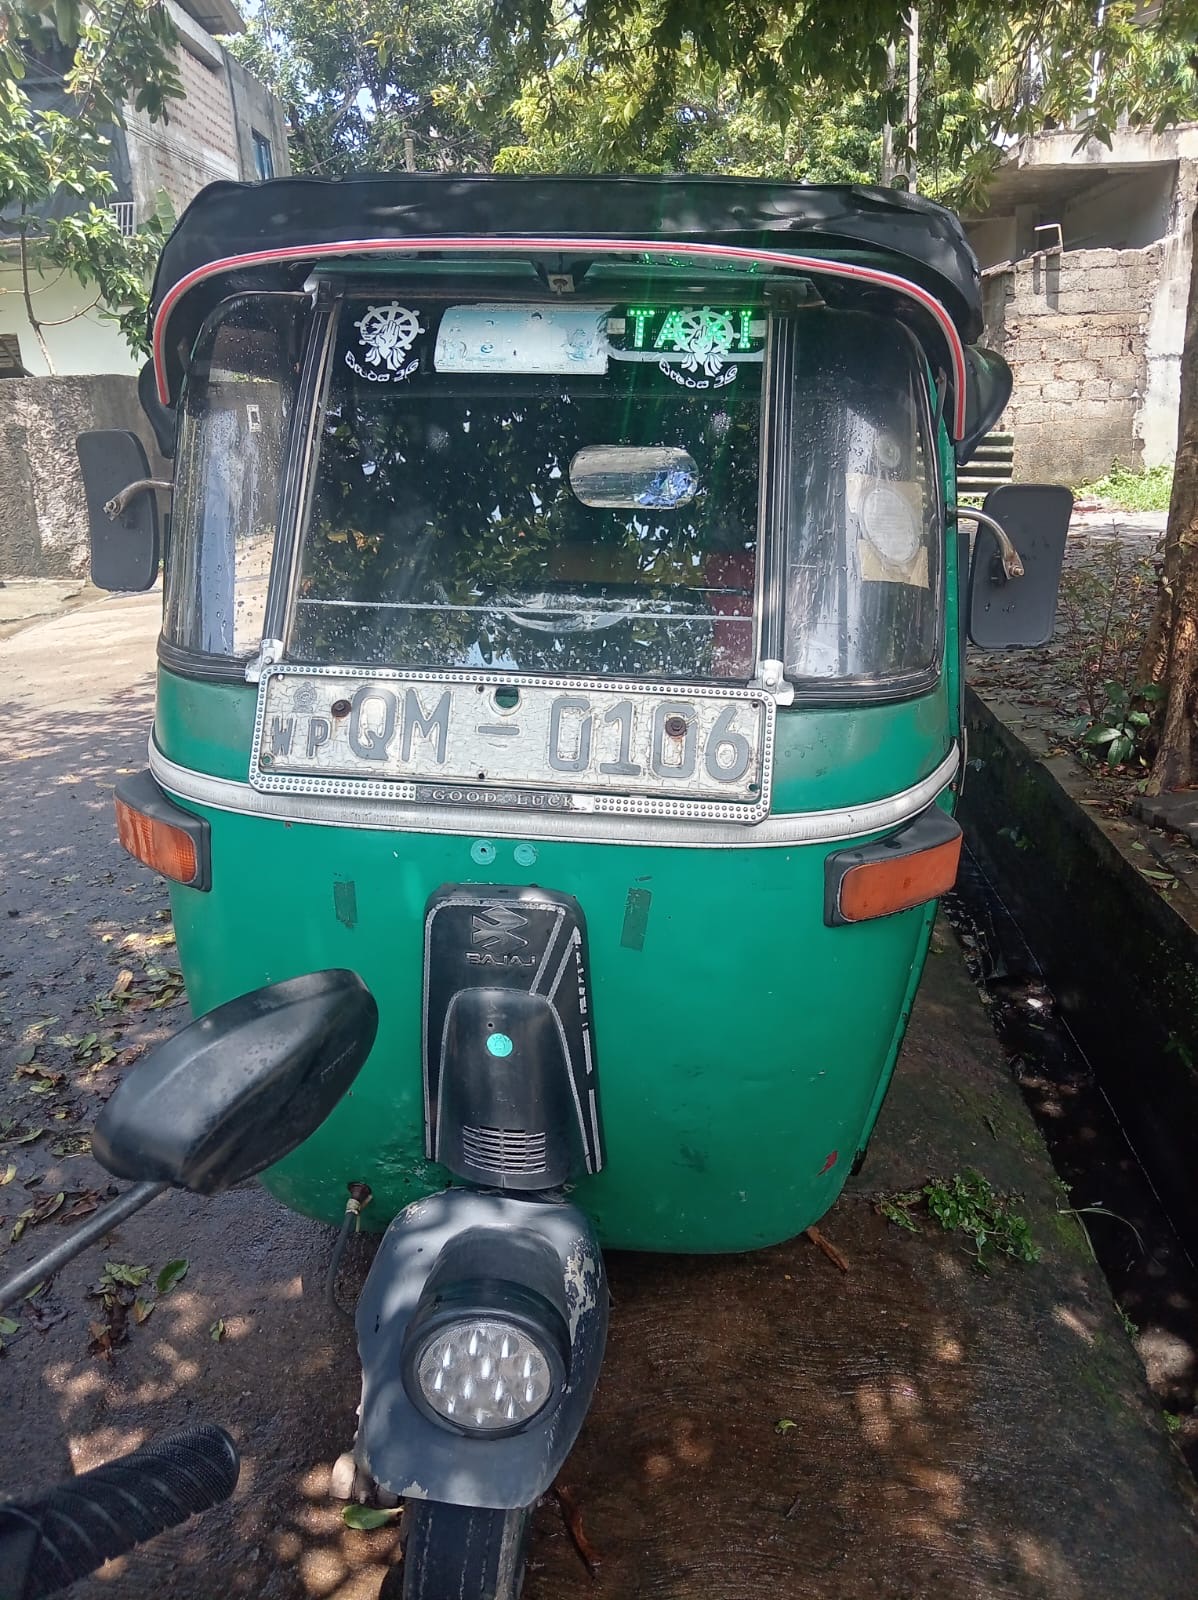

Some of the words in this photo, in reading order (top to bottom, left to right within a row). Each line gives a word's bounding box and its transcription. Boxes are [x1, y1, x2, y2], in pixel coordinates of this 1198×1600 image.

[549, 697, 750, 782] 0106
[432, 789, 497, 802] GOOD
[516, 794, 575, 807] LUCK
[465, 951, 536, 967] BAJAJ
